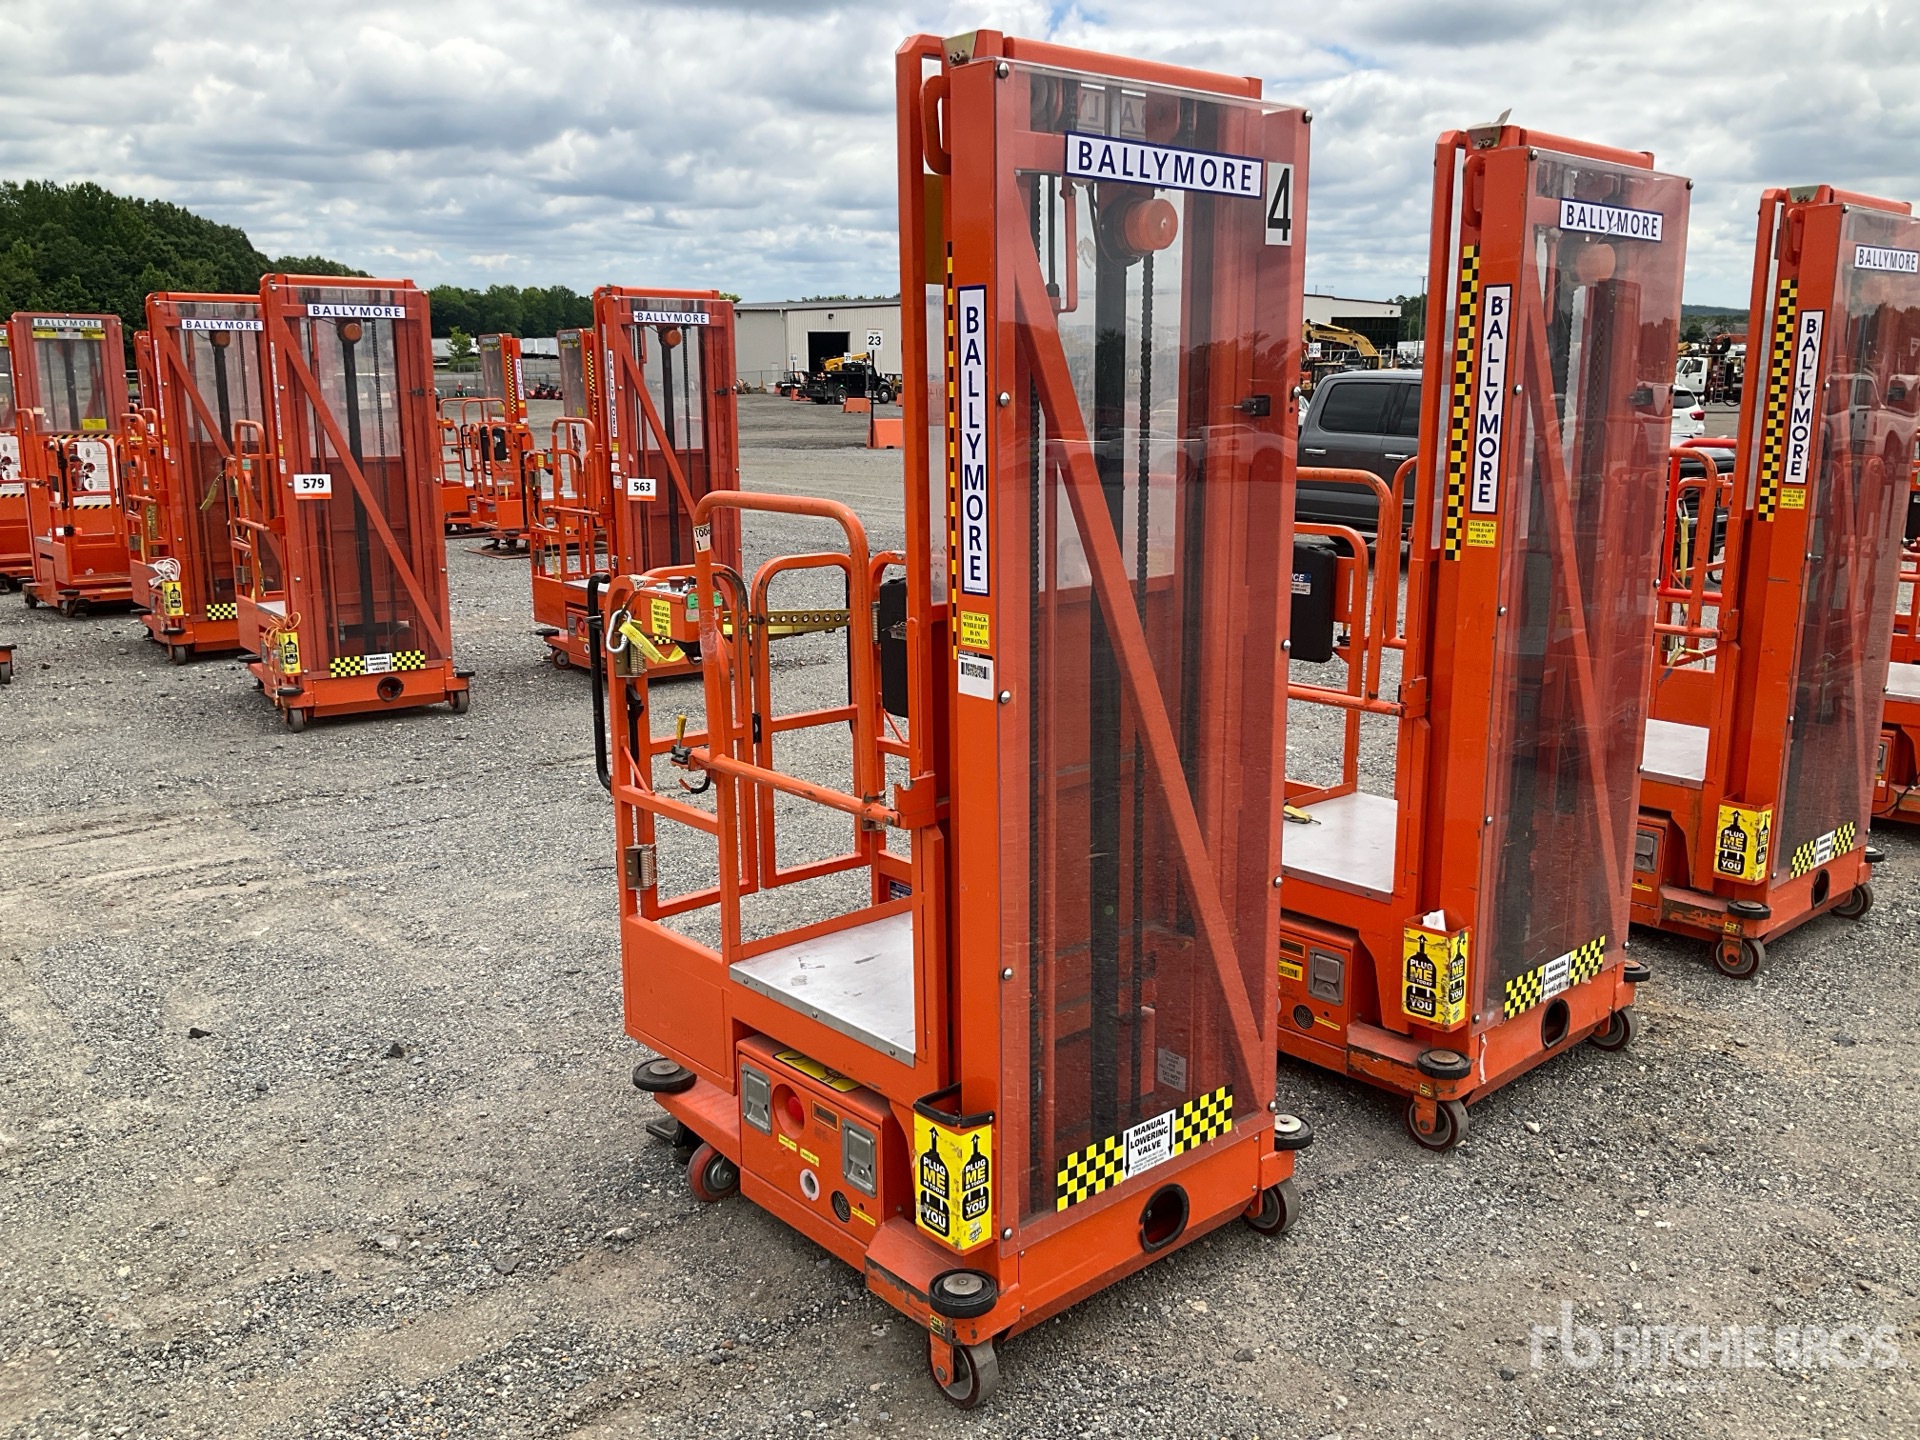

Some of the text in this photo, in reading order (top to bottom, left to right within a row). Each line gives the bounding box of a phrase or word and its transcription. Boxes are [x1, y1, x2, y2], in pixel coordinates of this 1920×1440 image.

[1077, 140, 1252, 192] BALLYMORE
[1267, 168, 1292, 242] 4
[1565, 204, 1659, 237] BALLYMORE
[1857, 248, 1917, 271] BALLYMORE
[312, 305, 402, 318] BALLYMORE
[637, 312, 706, 323] BALLYMORE
[37, 319, 99, 328] BALLYMORE
[185, 319, 260, 330] BALLYMORE
[868, 335, 881, 346] 23
[1478, 295, 1504, 503] BALLYMORE
[1790, 318, 1817, 476] BALLYMORE
[963, 305, 984, 582] BALLYMORE
[302, 477, 325, 490] 579
[633, 481, 651, 492] 563
[974, 615, 988, 623] BACK
[963, 621, 988, 631] WHILE LIFT
[962, 636, 988, 645] OPERATION
[1724, 829, 1745, 839] PLUG
[1723, 836, 1744, 848] ME
[1721, 860, 1741, 870] YOU
[1409, 958, 1433, 971] PLUG
[1451, 965, 1464, 976] ME
[1548, 960, 1567, 973] MANUAL
[1409, 966, 1433, 982] ME
[1545, 969, 1567, 985] LOWERING
[1416, 978, 1433, 987] TODAY
[1548, 982, 1562, 993] VALVE
[1450, 989, 1463, 998] YOU
[1410, 998, 1433, 1011] YOU
[1133, 1117, 1166, 1138] MANUAL
[1130, 1125, 1169, 1149] LOWERING
[1137, 1138, 1162, 1156] VALVE
[923, 1156, 946, 1176] PLUG
[965, 1158, 986, 1173] PLUG
[923, 1166, 946, 1191] ME
[965, 1167, 986, 1185] ME
[923, 1179, 946, 1196] IN TODAY
[970, 1178, 986, 1188] TODAY
[965, 1198, 986, 1215] YOU
[924, 1208, 946, 1229] YOU
